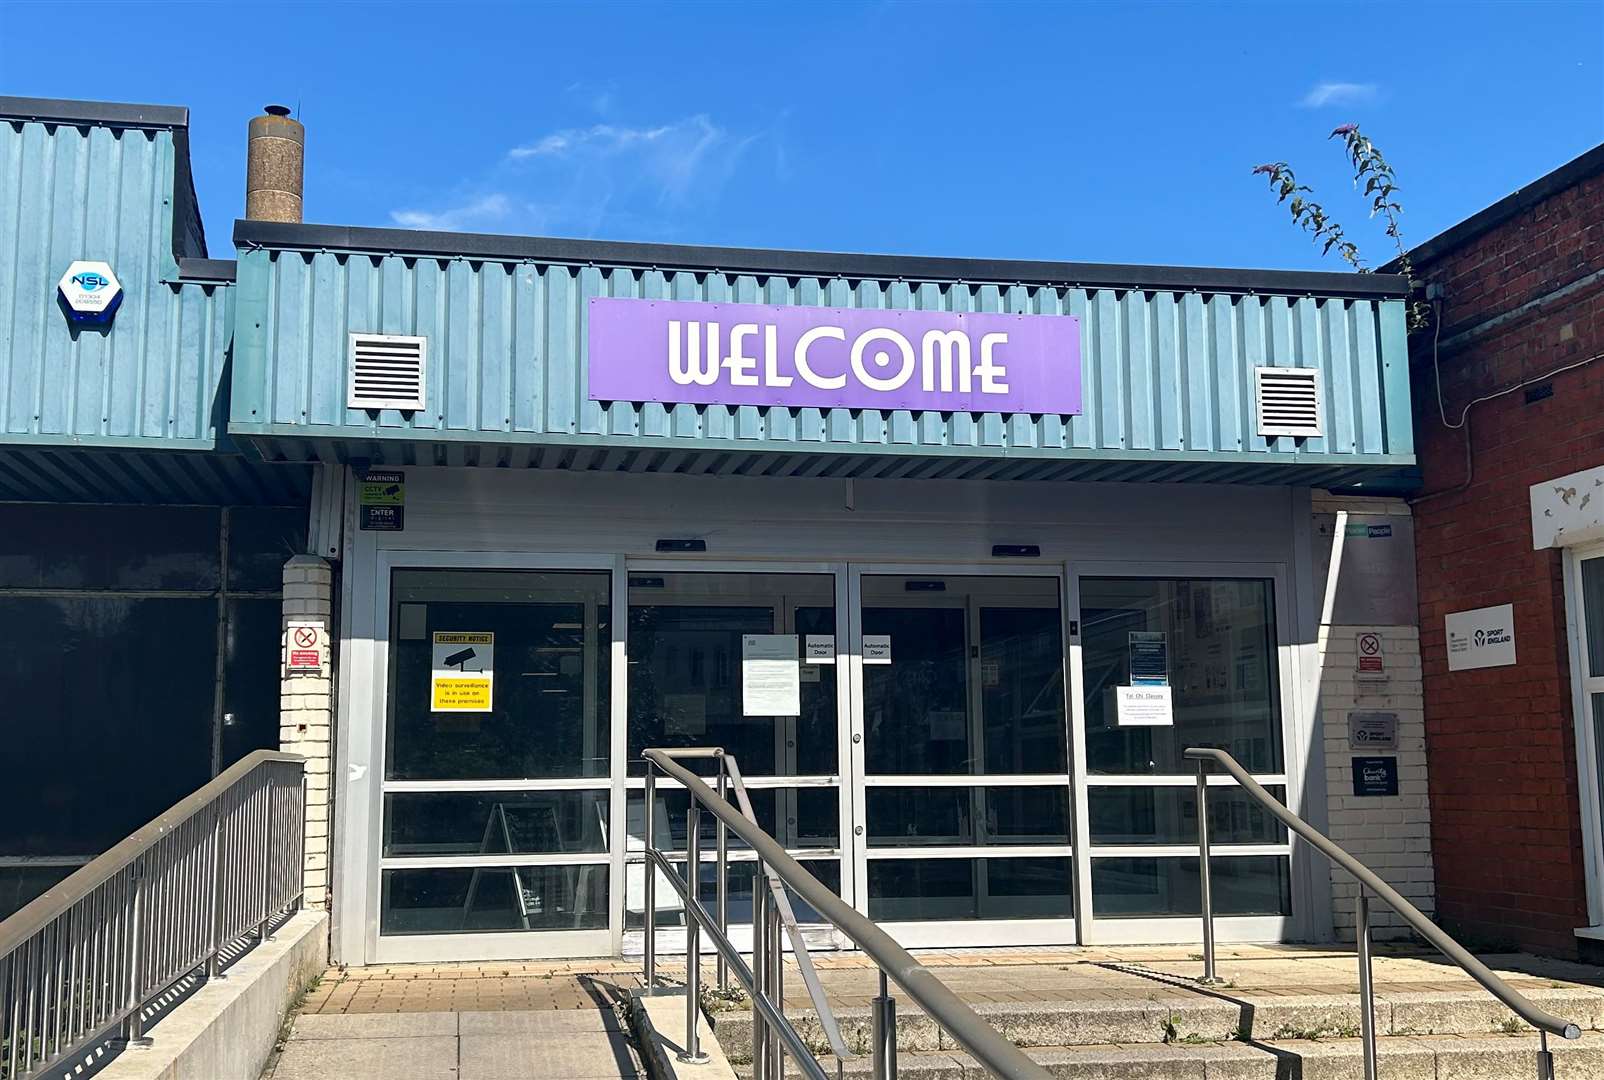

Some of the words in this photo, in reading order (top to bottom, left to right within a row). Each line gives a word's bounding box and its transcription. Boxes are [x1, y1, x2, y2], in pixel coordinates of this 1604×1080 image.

[72, 275, 109, 286] NSL
[667, 320, 1009, 394] WELCOME
[1486, 628, 1504, 637] SPORT
[1487, 635, 1511, 645] ENGLAND
[1363, 767, 1387, 778] Charity
[1364, 774, 1381, 782] bank
